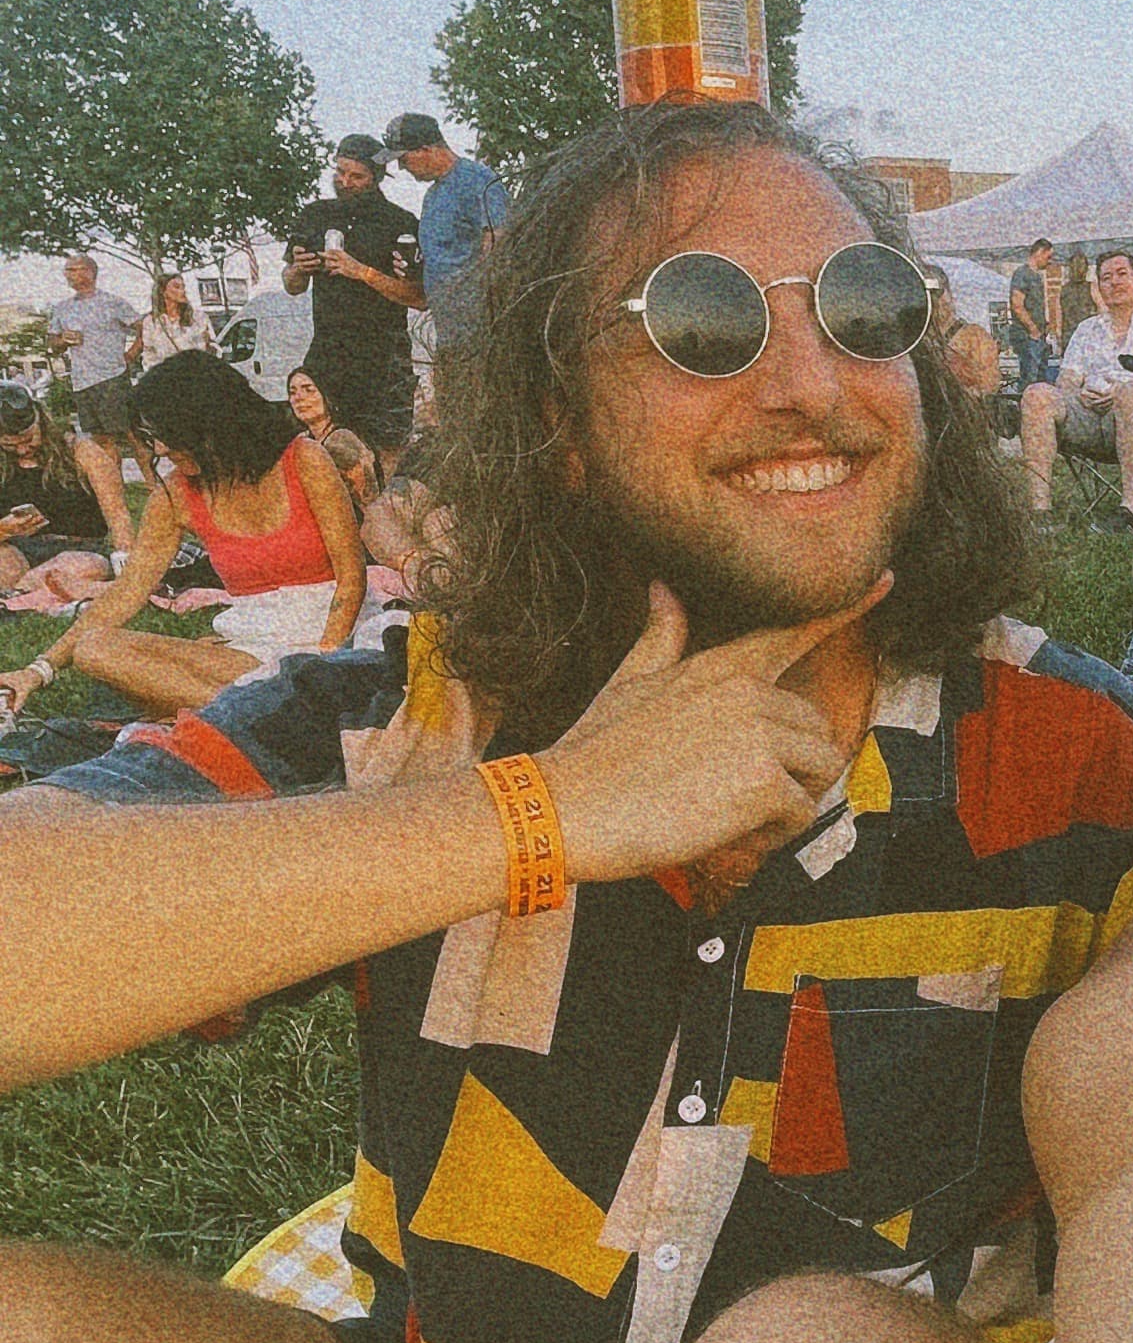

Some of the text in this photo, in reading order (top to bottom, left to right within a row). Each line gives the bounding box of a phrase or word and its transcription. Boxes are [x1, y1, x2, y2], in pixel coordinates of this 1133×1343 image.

[513, 773, 533, 791] 21
[524, 798, 544, 823] 21
[533, 834, 552, 863] 21
[535, 872, 554, 898] 21
